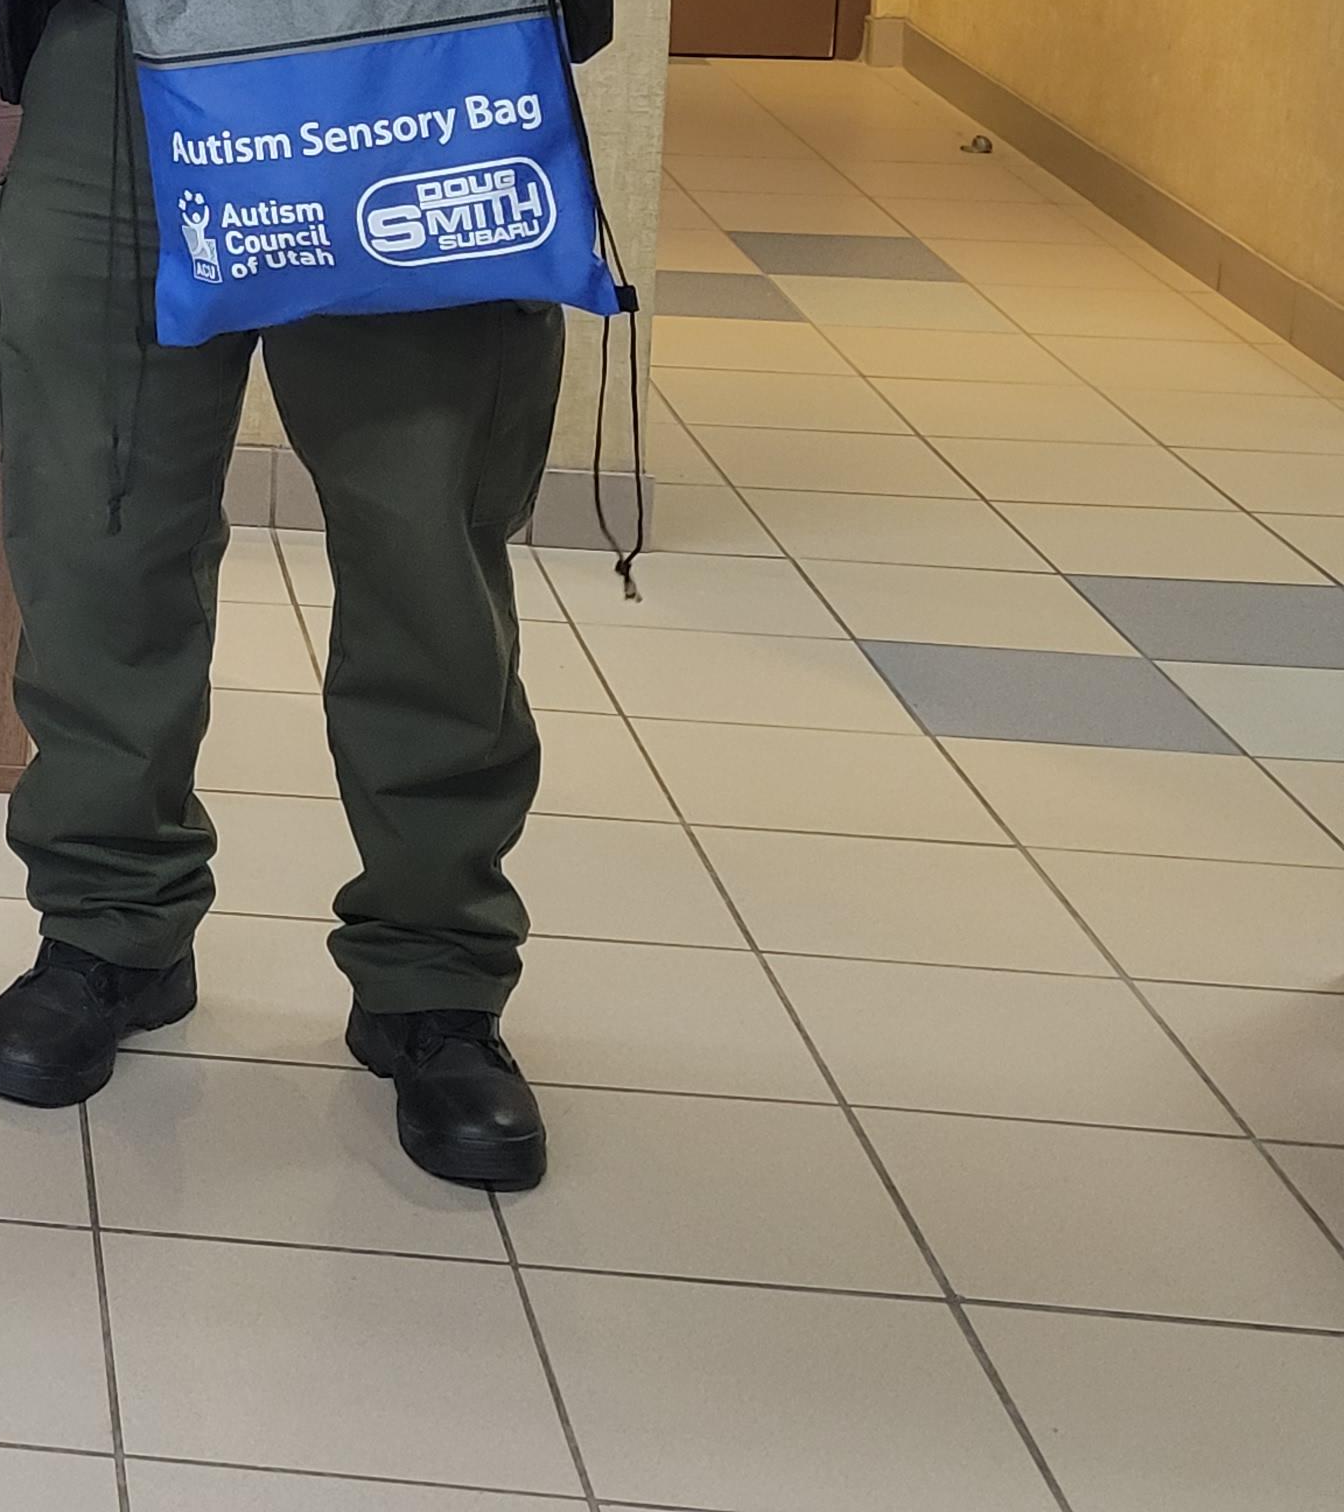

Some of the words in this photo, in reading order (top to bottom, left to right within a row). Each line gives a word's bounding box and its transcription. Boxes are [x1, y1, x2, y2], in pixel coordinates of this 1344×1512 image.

[171, 130, 293, 166] Autism
[301, 107, 456, 156] Sensory
[465, 92, 543, 131] Bag
[416, 169, 516, 203] DOUG
[221, 199, 325, 229] Autism
[368, 181, 543, 253] SMITH
[225, 225, 331, 255] Council
[438, 219, 541, 251] SUBARU
[231, 252, 259, 279] of
[265, 246, 335, 269] Utah
